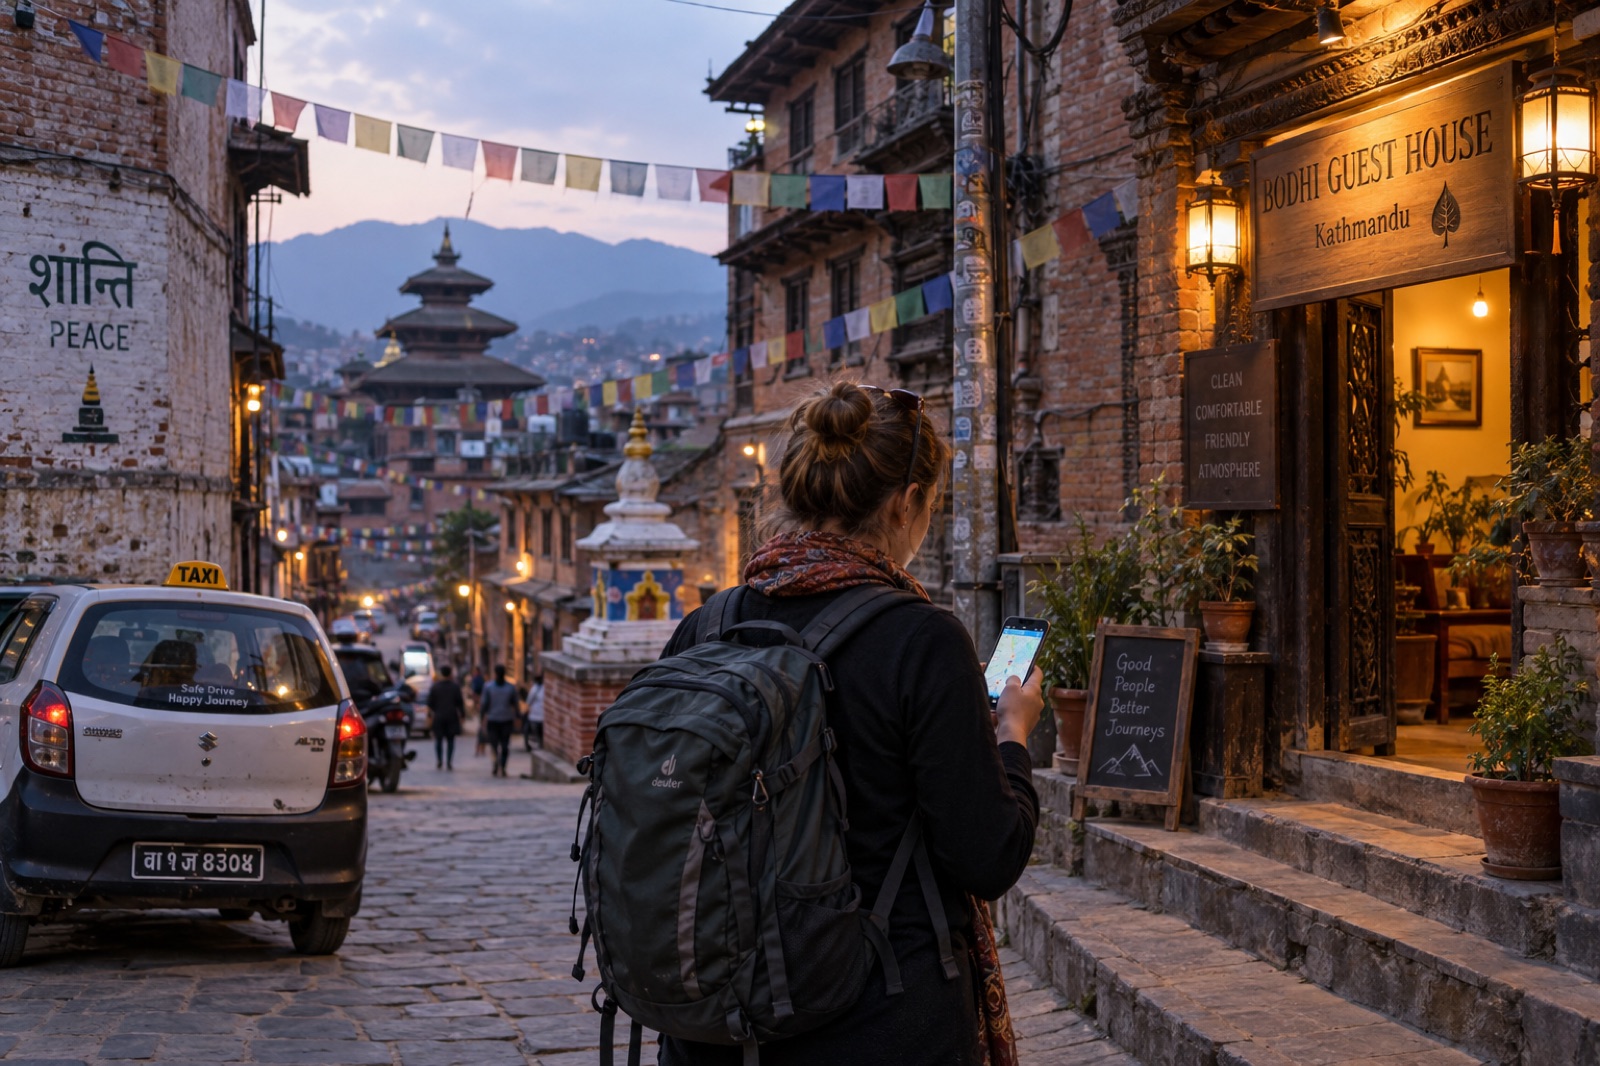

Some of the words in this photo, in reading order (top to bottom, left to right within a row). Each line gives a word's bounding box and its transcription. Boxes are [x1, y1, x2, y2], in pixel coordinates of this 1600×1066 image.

[1263, 162, 1320, 213] BODHI
[1327, 138, 1398, 195] GUEST
[1405, 110, 1493, 175] HOUSE
[1314, 203, 1411, 249] Kathmandu
[29, 240, 138, 309] शान्ति
[50, 320, 130, 351] PEACE
[1210, 371, 1243, 389] CLEAN
[1195, 400, 1263, 420] COMFORTABLE
[1204, 431, 1251, 449] FRIENDLY
[1198, 461, 1261, 479] ATMOSPHERE
[177, 565, 219, 584] TAXI
[1116, 652, 1153, 674] Good
[181, 683, 205, 694] Safe
[207, 685, 235, 696] Drive
[1114, 676, 1156, 698] People
[168, 693, 203, 707] Happy
[204, 695, 249, 709] Journey
[1108, 697, 1150, 714] Better
[1105, 718, 1166, 743] Journeys
[294, 736, 326, 746] ALTO
[651, 777, 684, 788] deuter
